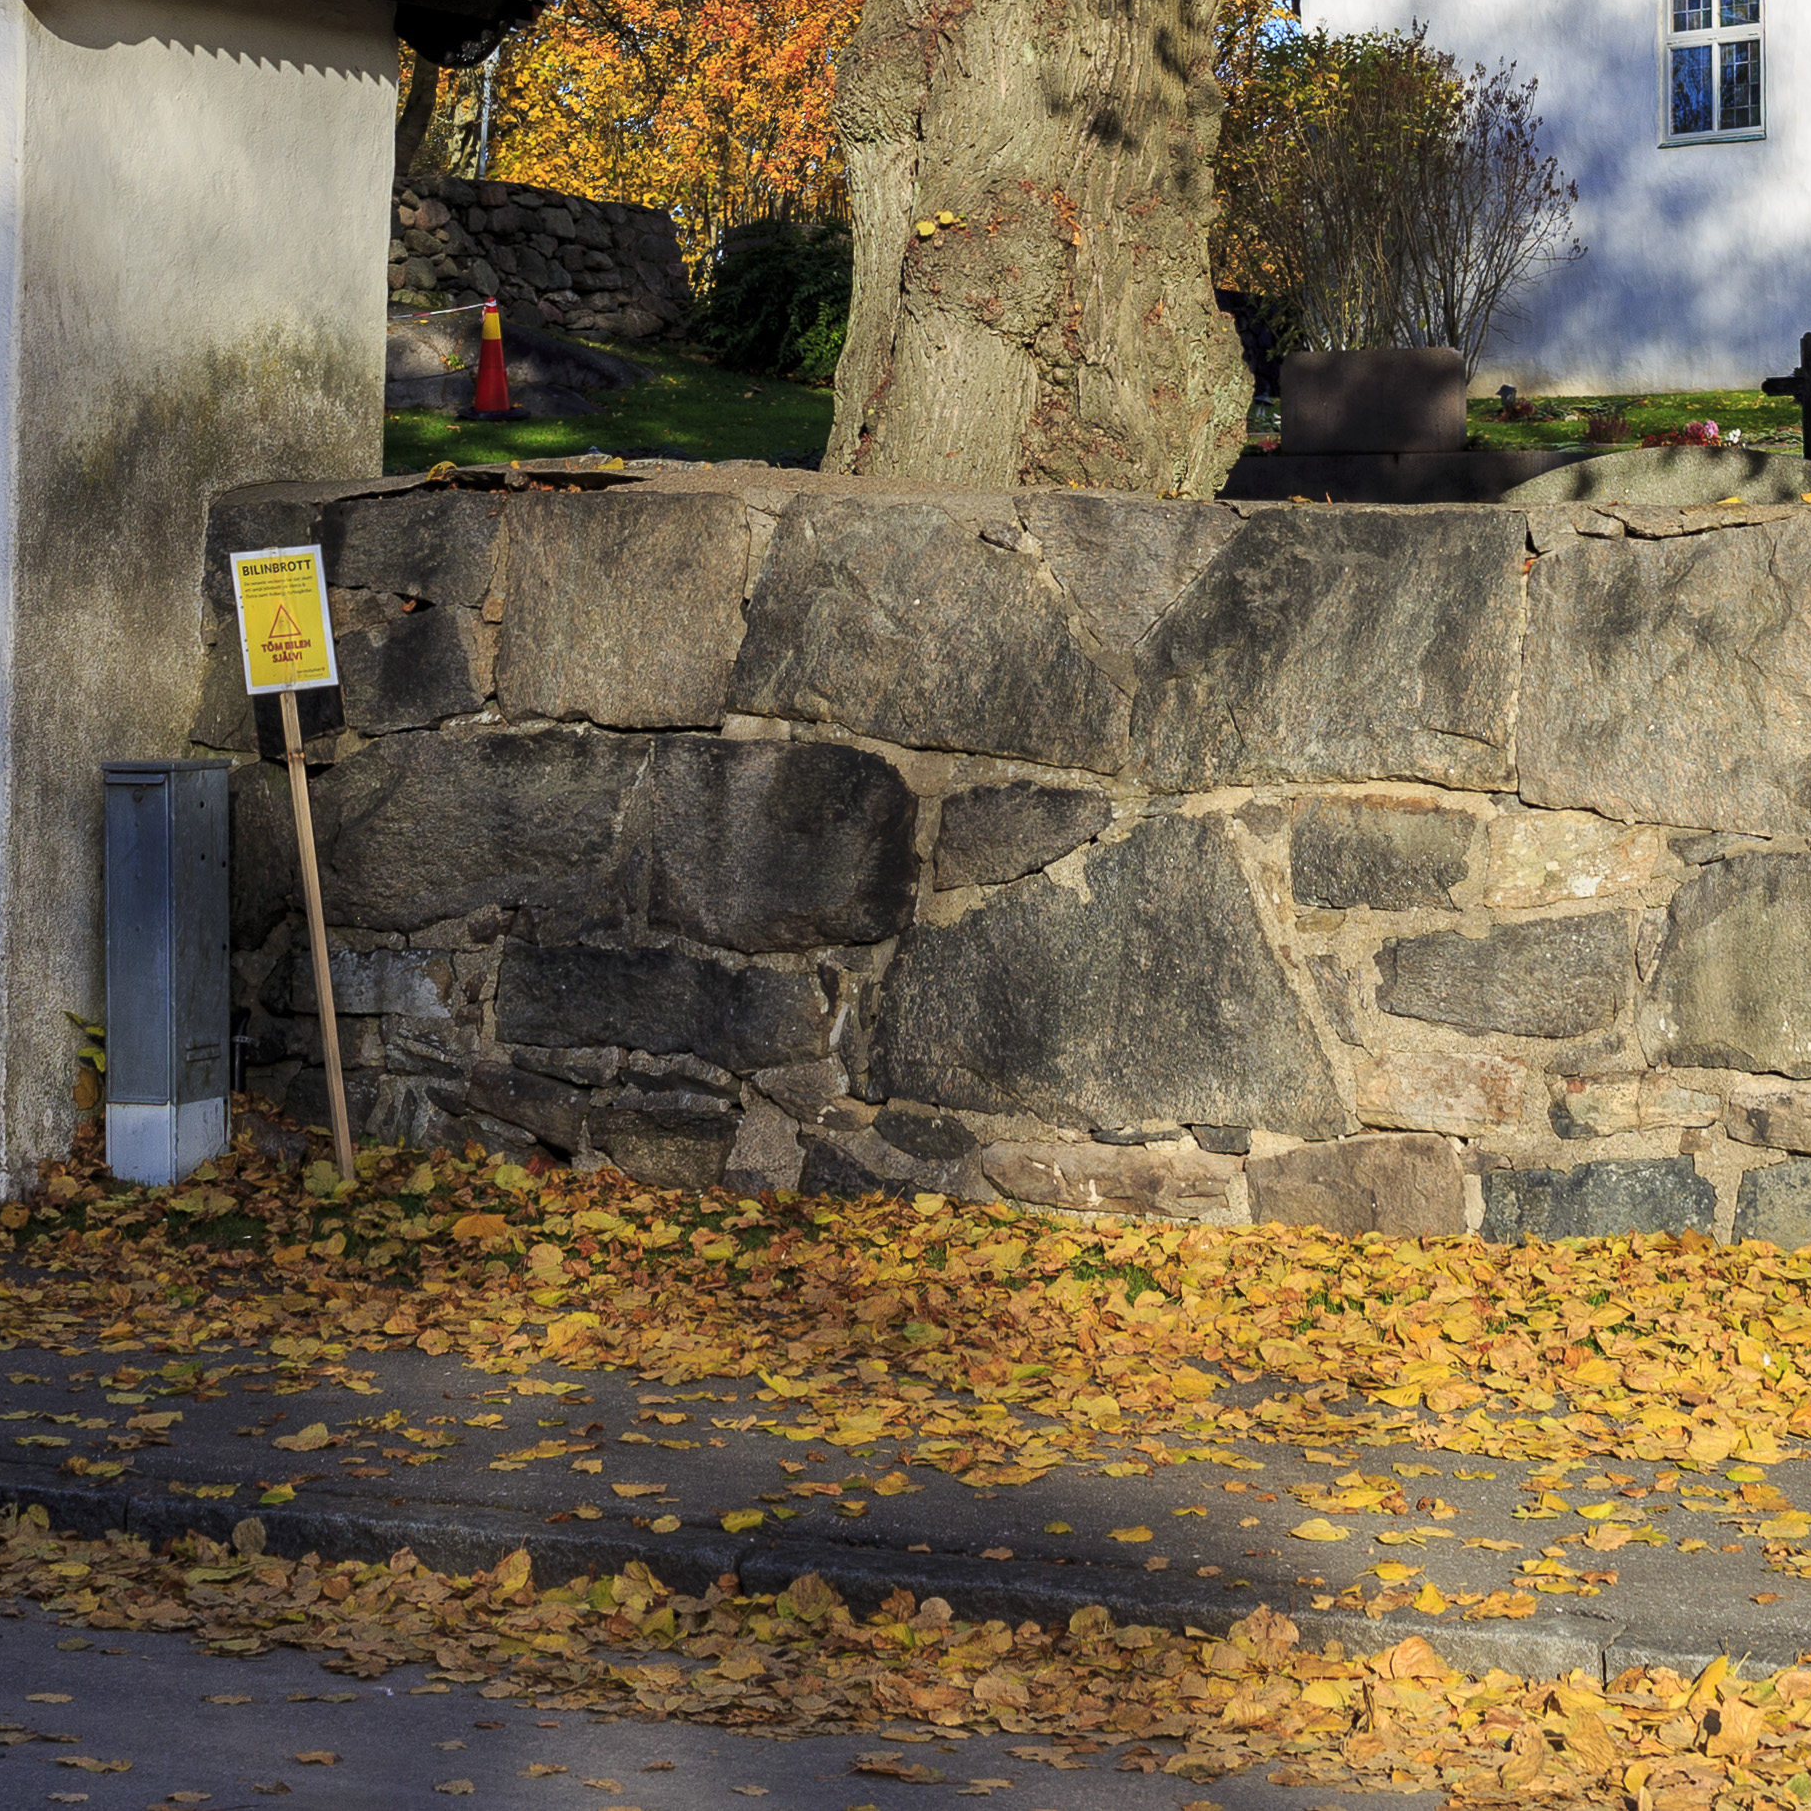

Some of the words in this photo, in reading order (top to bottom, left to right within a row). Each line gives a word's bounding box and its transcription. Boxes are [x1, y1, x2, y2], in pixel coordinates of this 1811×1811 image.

[242, 559, 311, 576] BILINBROTT
[261, 641, 283, 653] TÖM
[285, 639, 311, 650] BILEN
